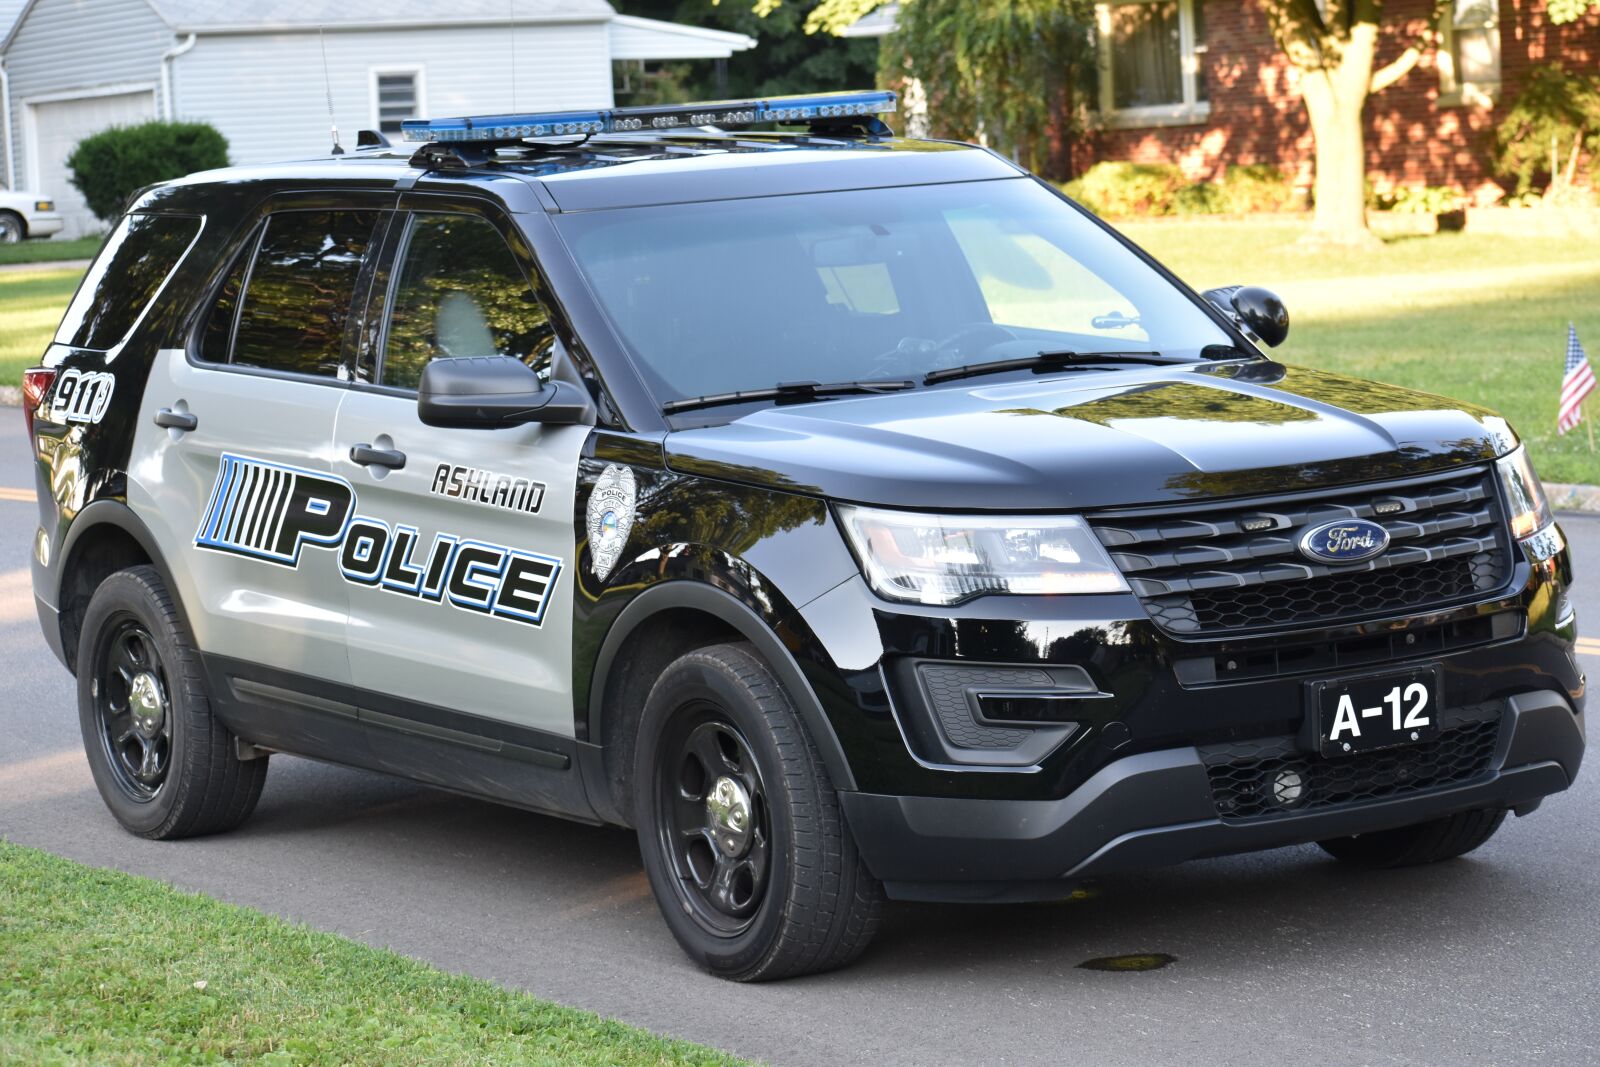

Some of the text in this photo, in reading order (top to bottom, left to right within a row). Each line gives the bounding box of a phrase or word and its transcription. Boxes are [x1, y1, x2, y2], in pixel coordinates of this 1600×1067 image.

[430, 463, 546, 514] ASHLAND
[601, 489, 627, 502] POLICE
[1327, 526, 1374, 552] Ford
[1330, 683, 1429, 740] A-12
